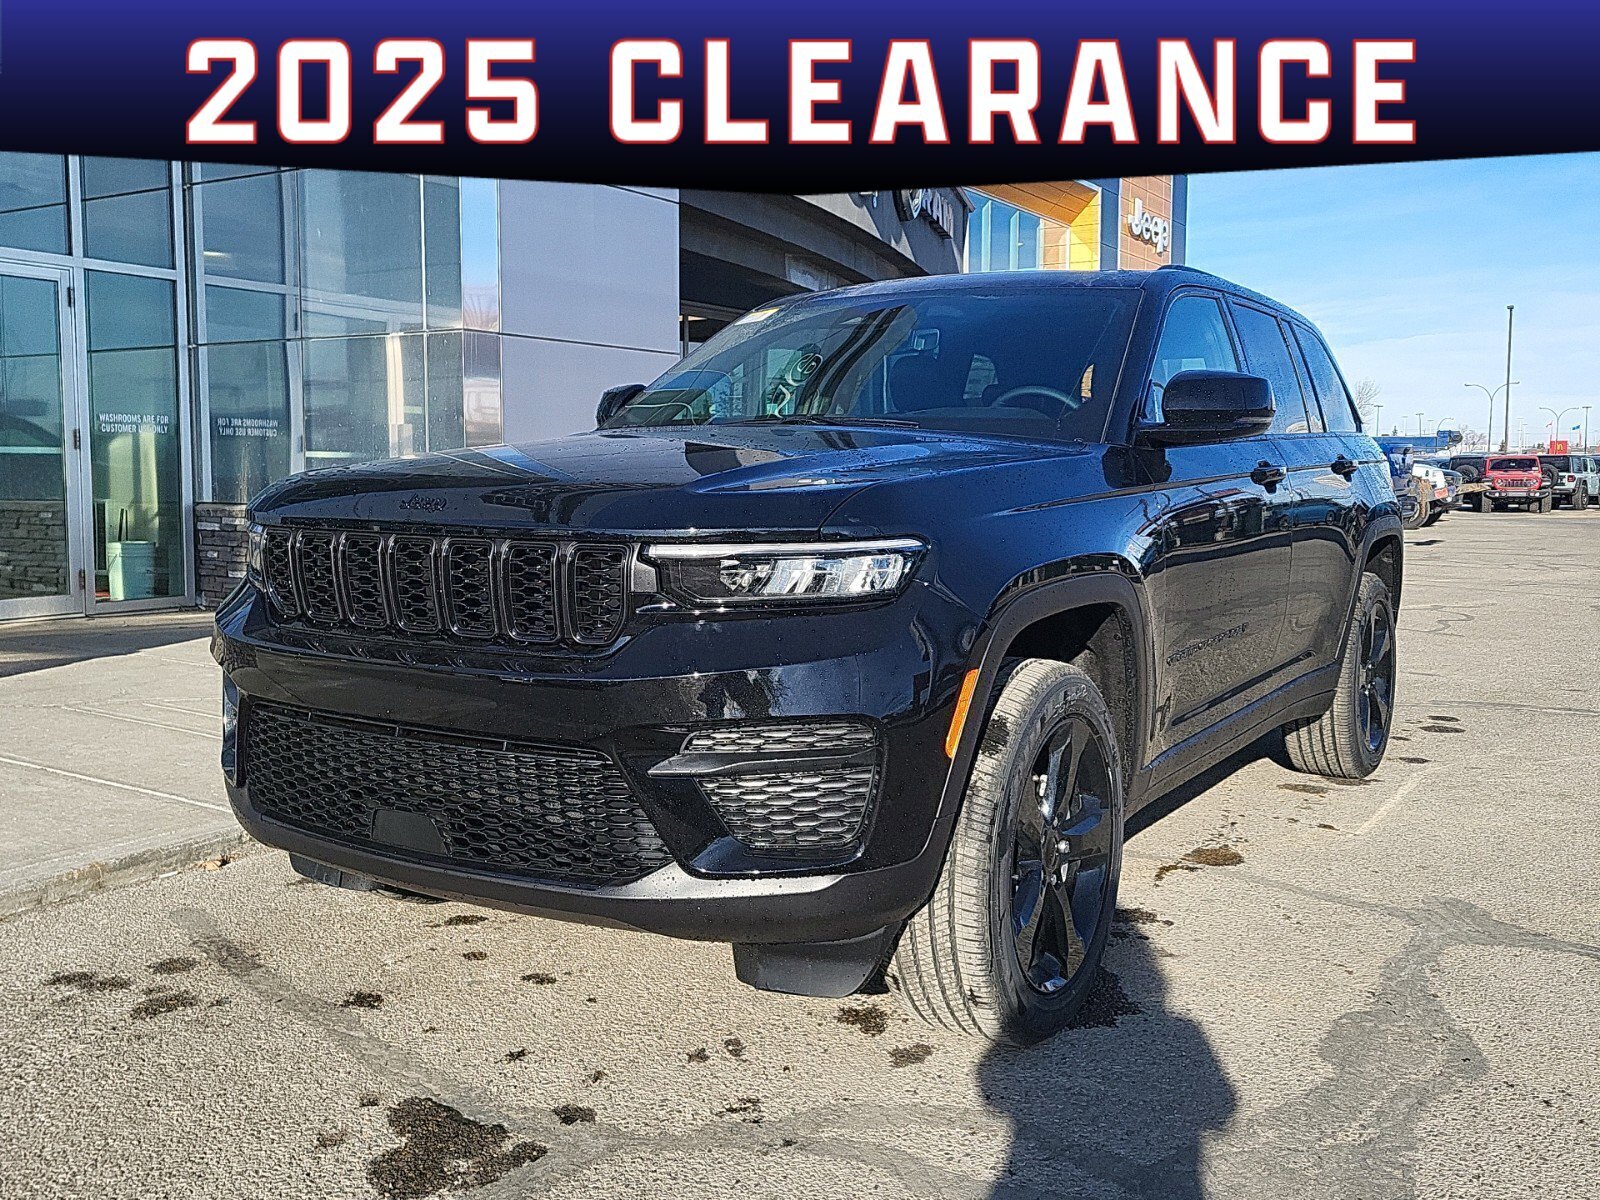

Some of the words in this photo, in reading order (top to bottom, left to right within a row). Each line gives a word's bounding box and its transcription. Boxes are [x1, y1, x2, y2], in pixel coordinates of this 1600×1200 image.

[1127, 197, 1169, 253] Jeep
[99, 413, 141, 423] WASHROOMS
[142, 414, 155, 424] ARE
[156, 415, 169, 424] FOR
[101, 423, 137, 433] CUSTOMER
